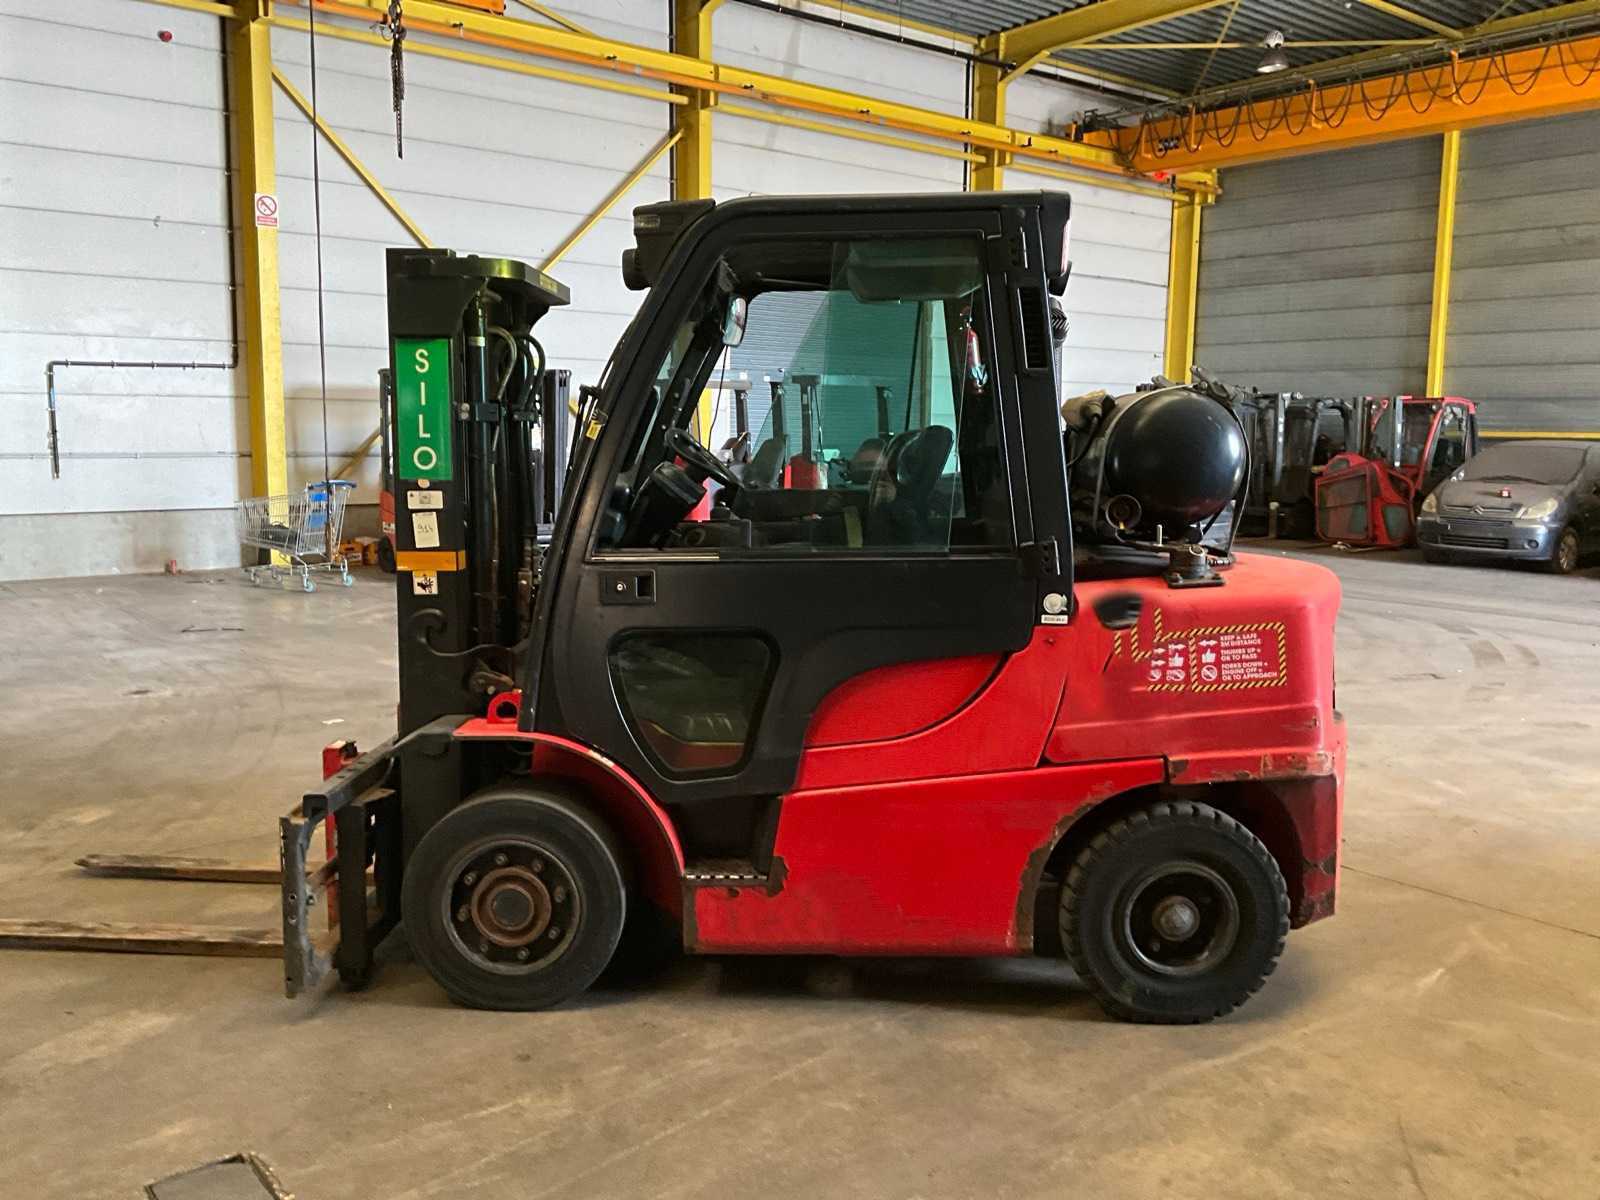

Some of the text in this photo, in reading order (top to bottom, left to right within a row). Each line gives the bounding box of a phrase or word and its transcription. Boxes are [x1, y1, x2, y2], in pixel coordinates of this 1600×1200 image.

[413, 348, 437, 470] SILO
[1231, 638, 1261, 646] DISTANCE
[1243, 671, 1278, 679] APPROACH
